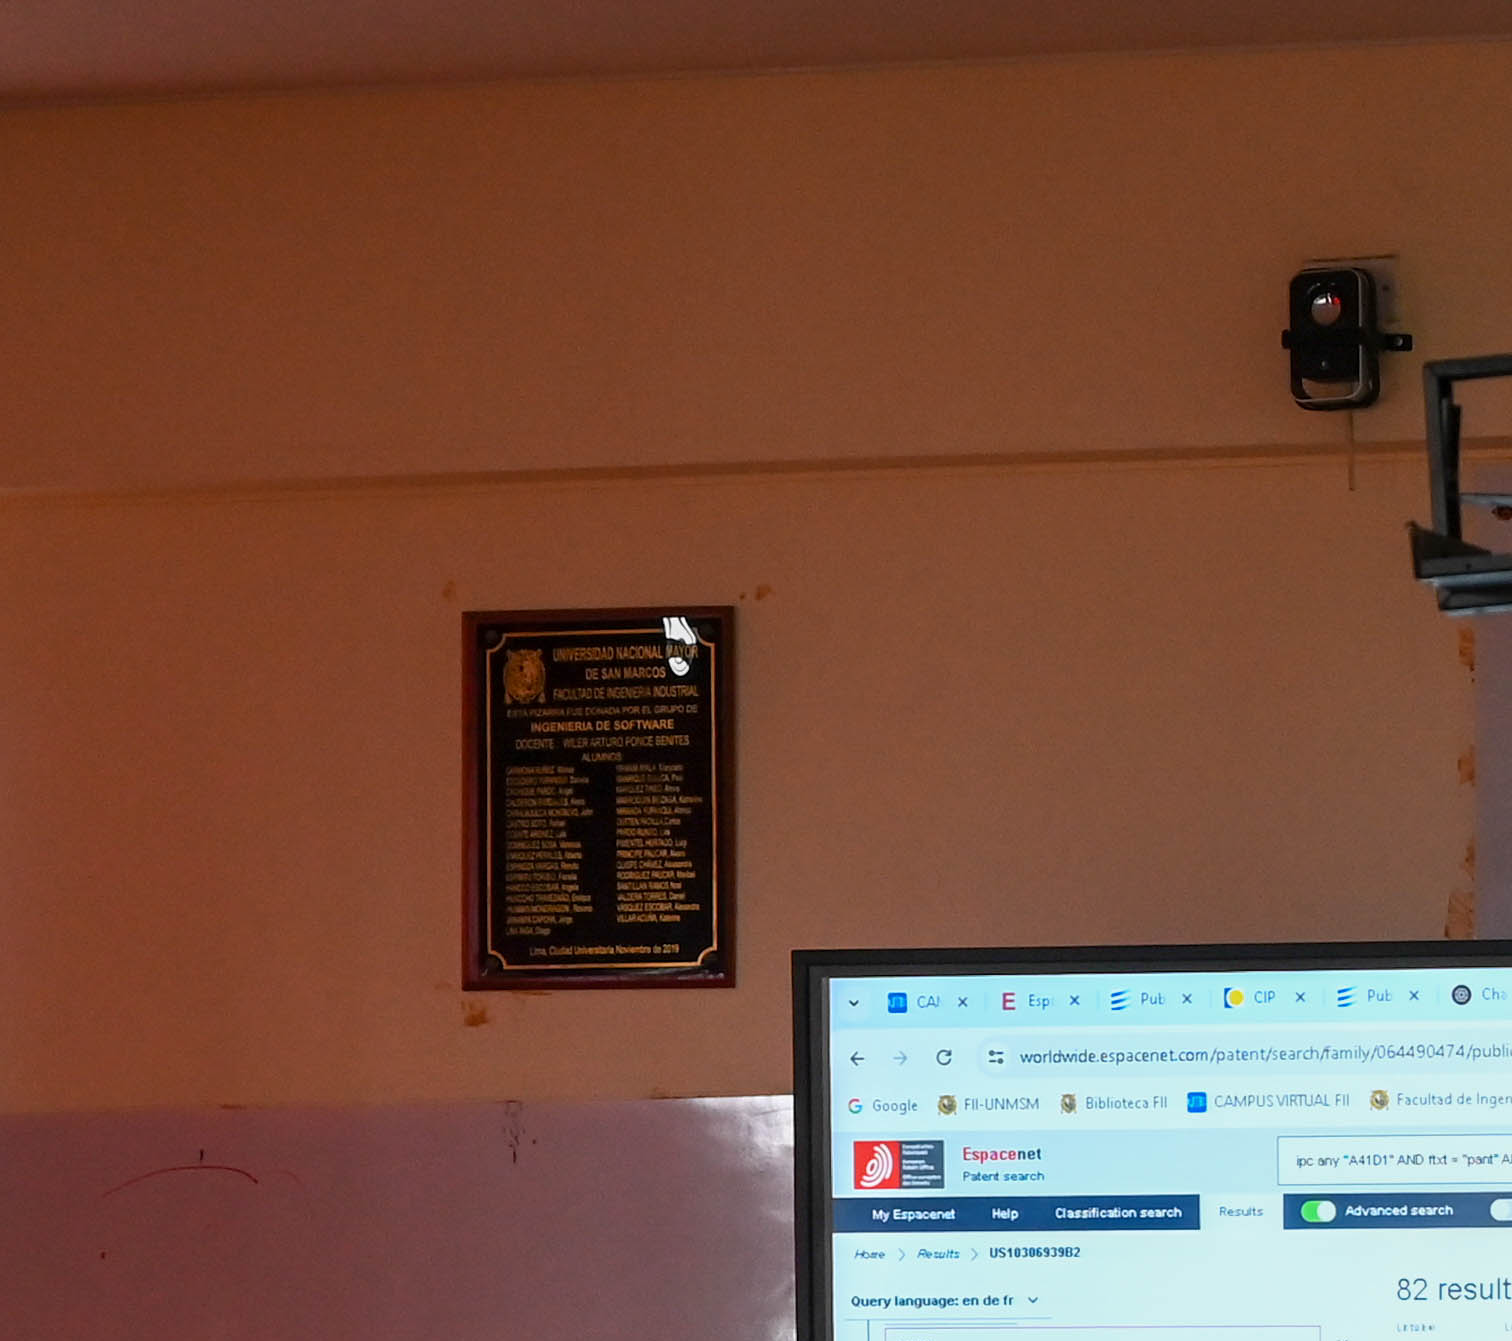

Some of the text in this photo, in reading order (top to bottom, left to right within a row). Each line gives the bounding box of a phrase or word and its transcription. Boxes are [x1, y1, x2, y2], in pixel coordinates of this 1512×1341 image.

[553, 647, 614, 661] UNIVERSIDAD
[616, 646, 663, 660] NACIONAL
[586, 666, 666, 680] DE SAN MARCOS
[531, 719, 674, 732] INGENIERIA DE SOFTWARE
[1254, 990, 1275, 1004] CIP
[964, 1096, 1040, 1111] FII-UNMSM
[1085, 1095, 1168, 1110] Biblioteca FII
[1214, 1093, 1350, 1108] CAMPUS VIRTUAL FII
[1397, 1092, 1453, 1106] Facultad
[1457, 1092, 1473, 1105] de
[873, 1098, 918, 1116] Google
[963, 1146, 1042, 1165] Espacenet
[963, 1170, 1045, 1182] Patent search
[872, 1208, 956, 1223] My Espacenet
[992, 1207, 1019, 1222] Help
[1055, 1206, 1182, 1219] Classification search
[1219, 1206, 1264, 1217] Results
[1345, 1204, 1454, 1217] Advanced search
[989, 1246, 1081, 1259] US10306939B2
[1396, 1277, 1428, 1301] 82
[850, 1294, 1014, 1310] Query language: en de fr
